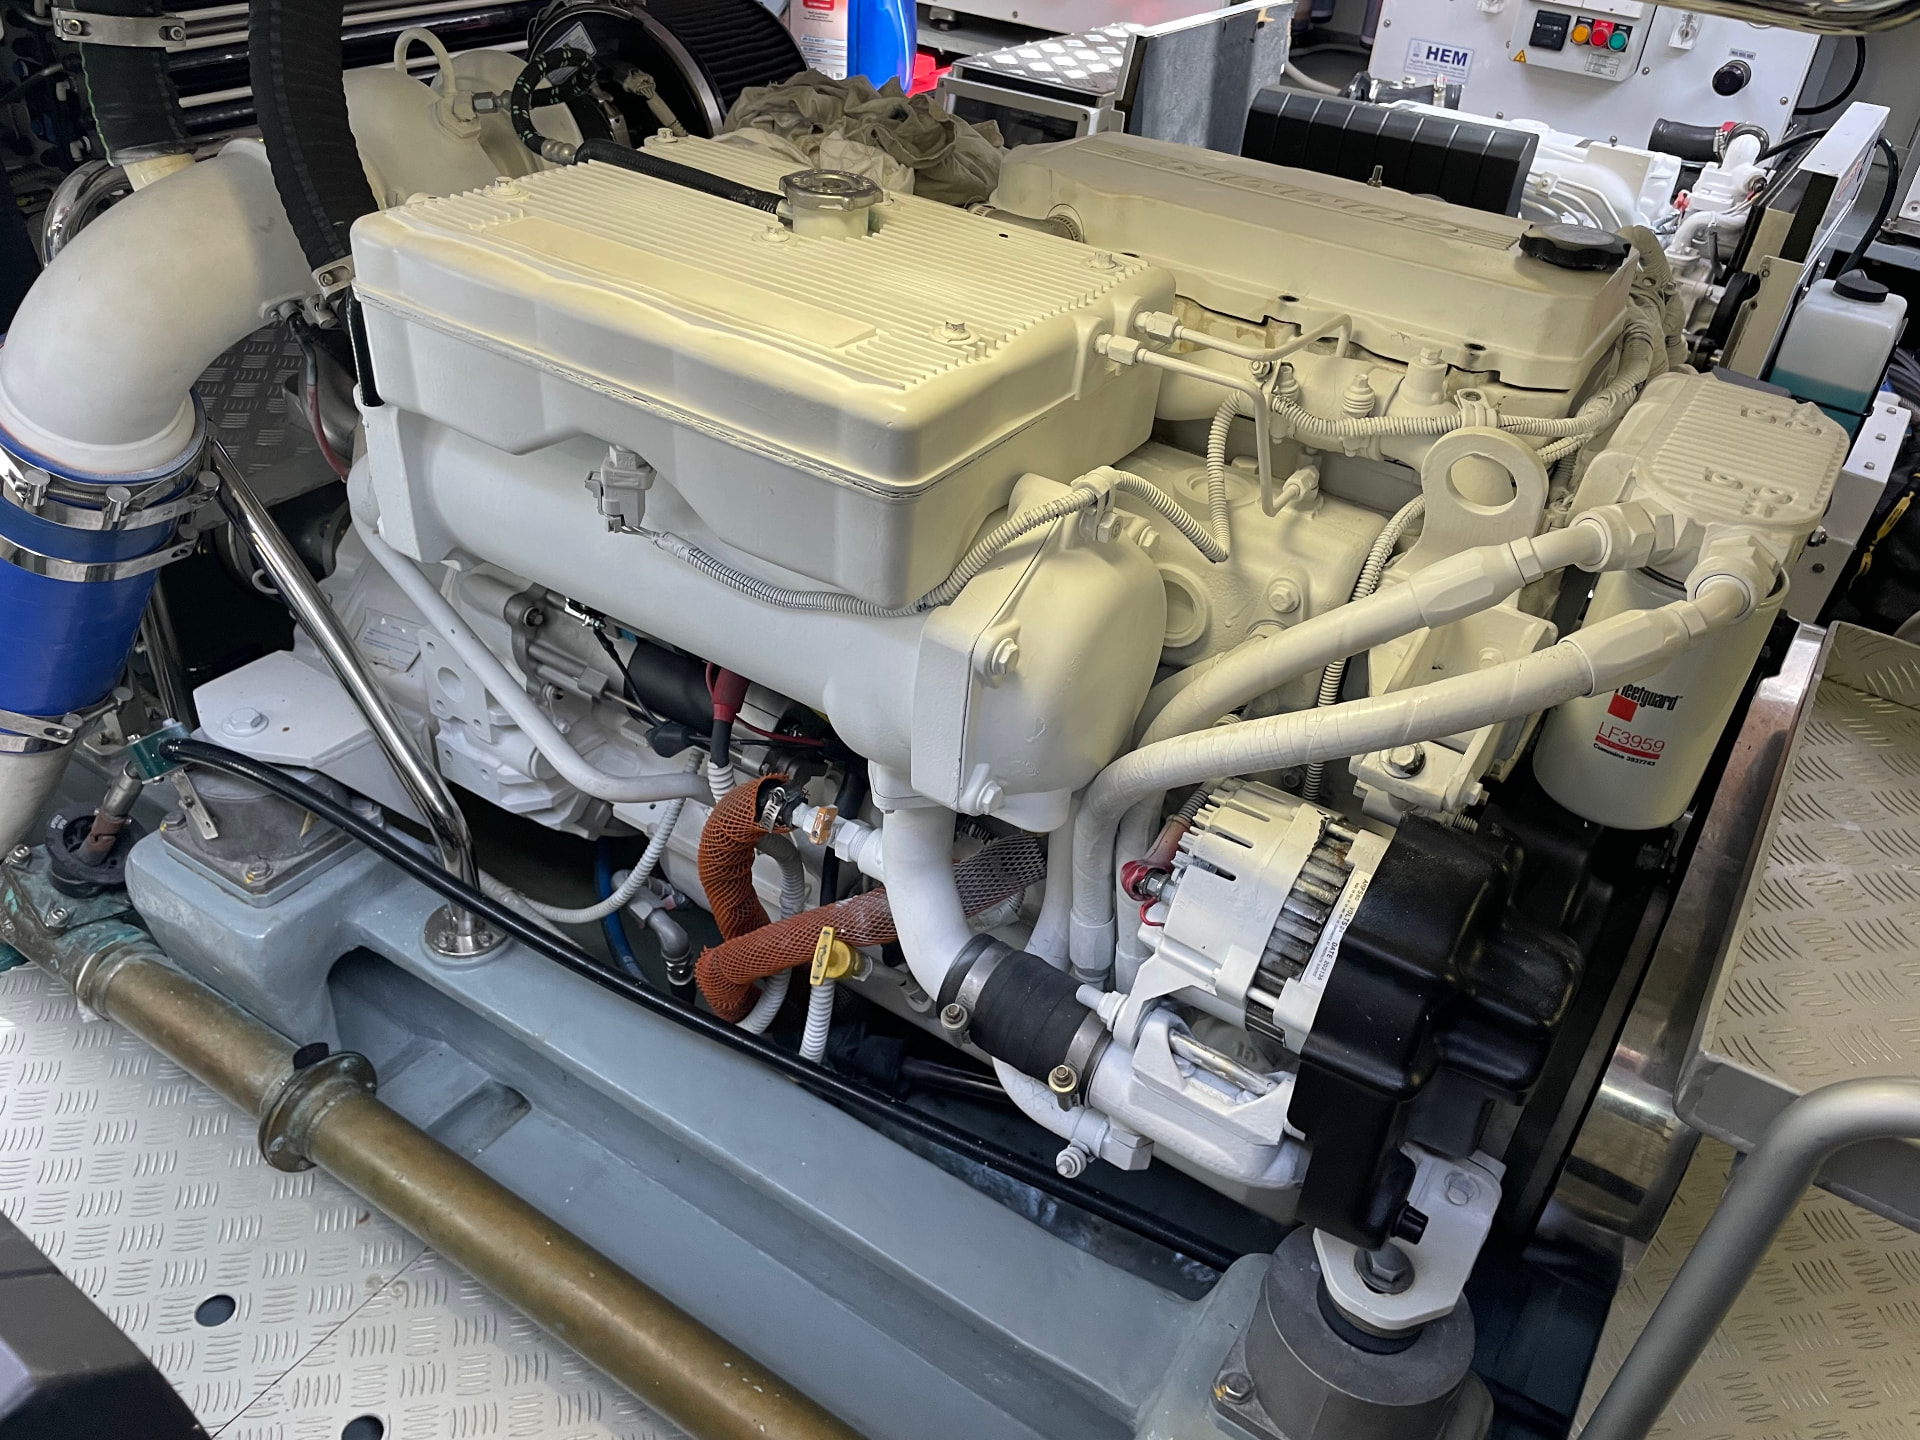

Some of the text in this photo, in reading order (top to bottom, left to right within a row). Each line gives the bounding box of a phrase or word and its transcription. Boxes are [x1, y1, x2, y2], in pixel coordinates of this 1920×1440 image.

[1426, 45, 1468, 67] HEM
[1599, 721, 1665, 753] LF3959
[1326, 942, 1339, 959] DATE
